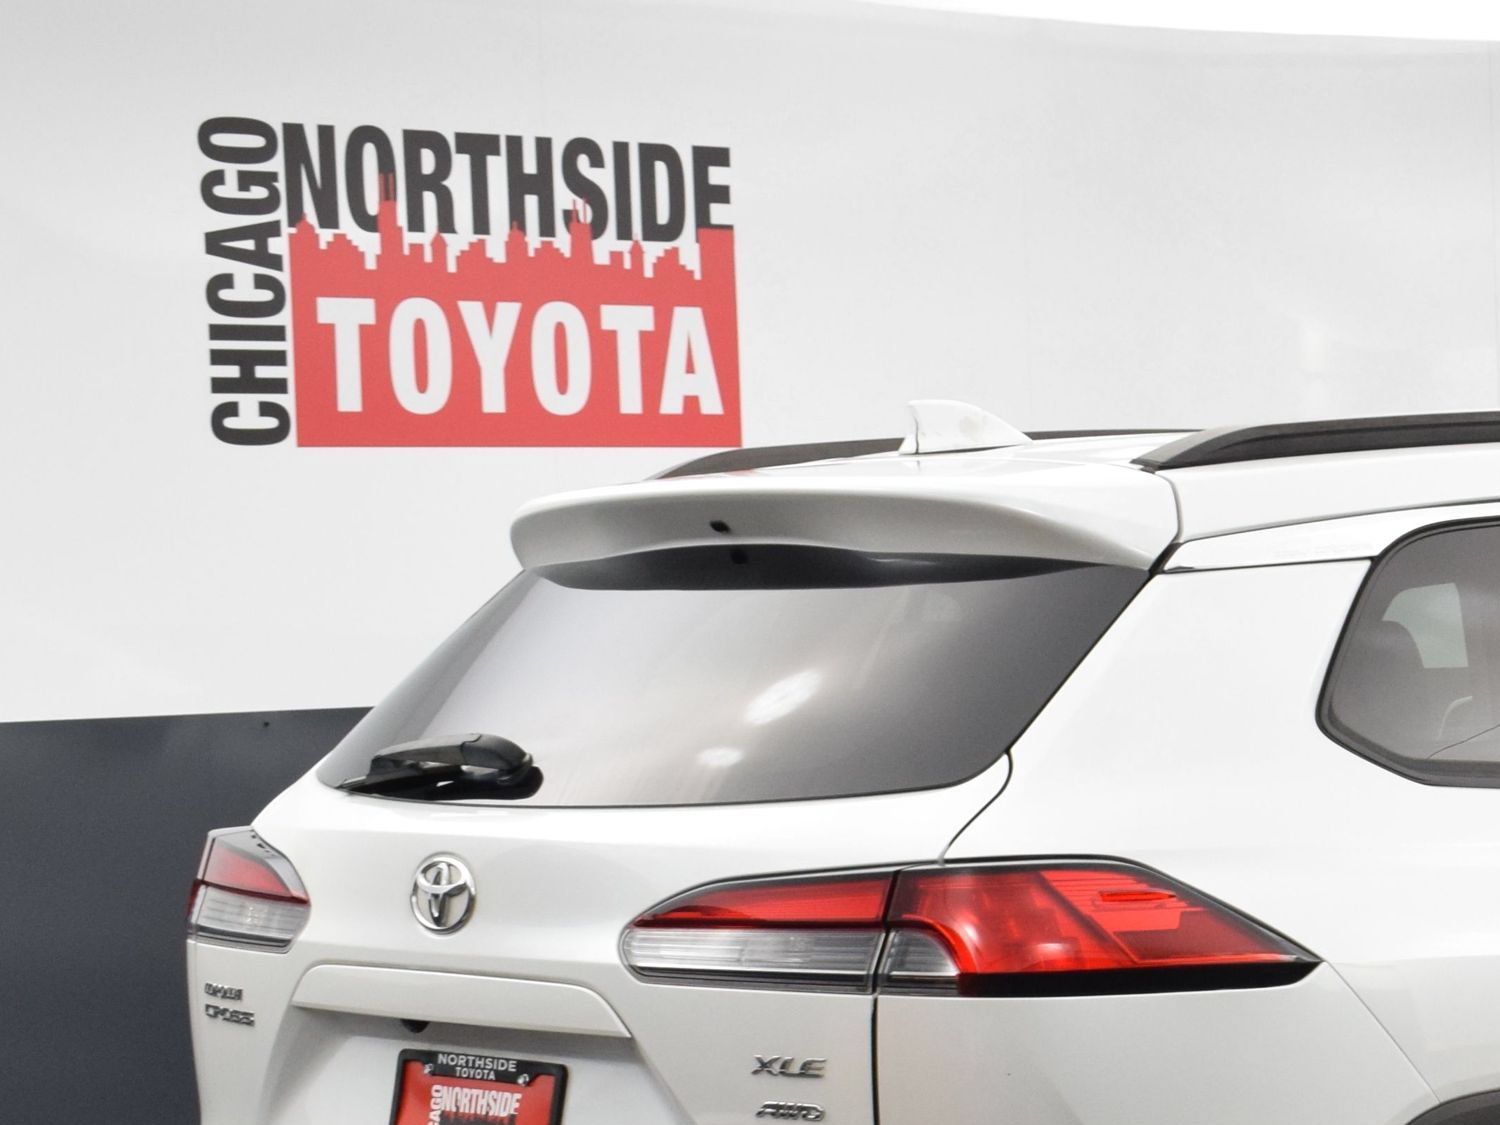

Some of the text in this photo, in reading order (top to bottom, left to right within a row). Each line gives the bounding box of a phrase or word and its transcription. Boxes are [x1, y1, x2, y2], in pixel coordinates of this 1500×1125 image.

[282, 122, 733, 242] NORTHSIDE
[197, 116, 290, 446] CHICAGO
[317, 297, 724, 416] TOYOTA
[437, 1053, 517, 1072] NORTHSIDE
[455, 1067, 496, 1081] TOYOTA
[751, 1054, 826, 1078] XLE
[442, 1086, 522, 1117] NORTHSIDE
